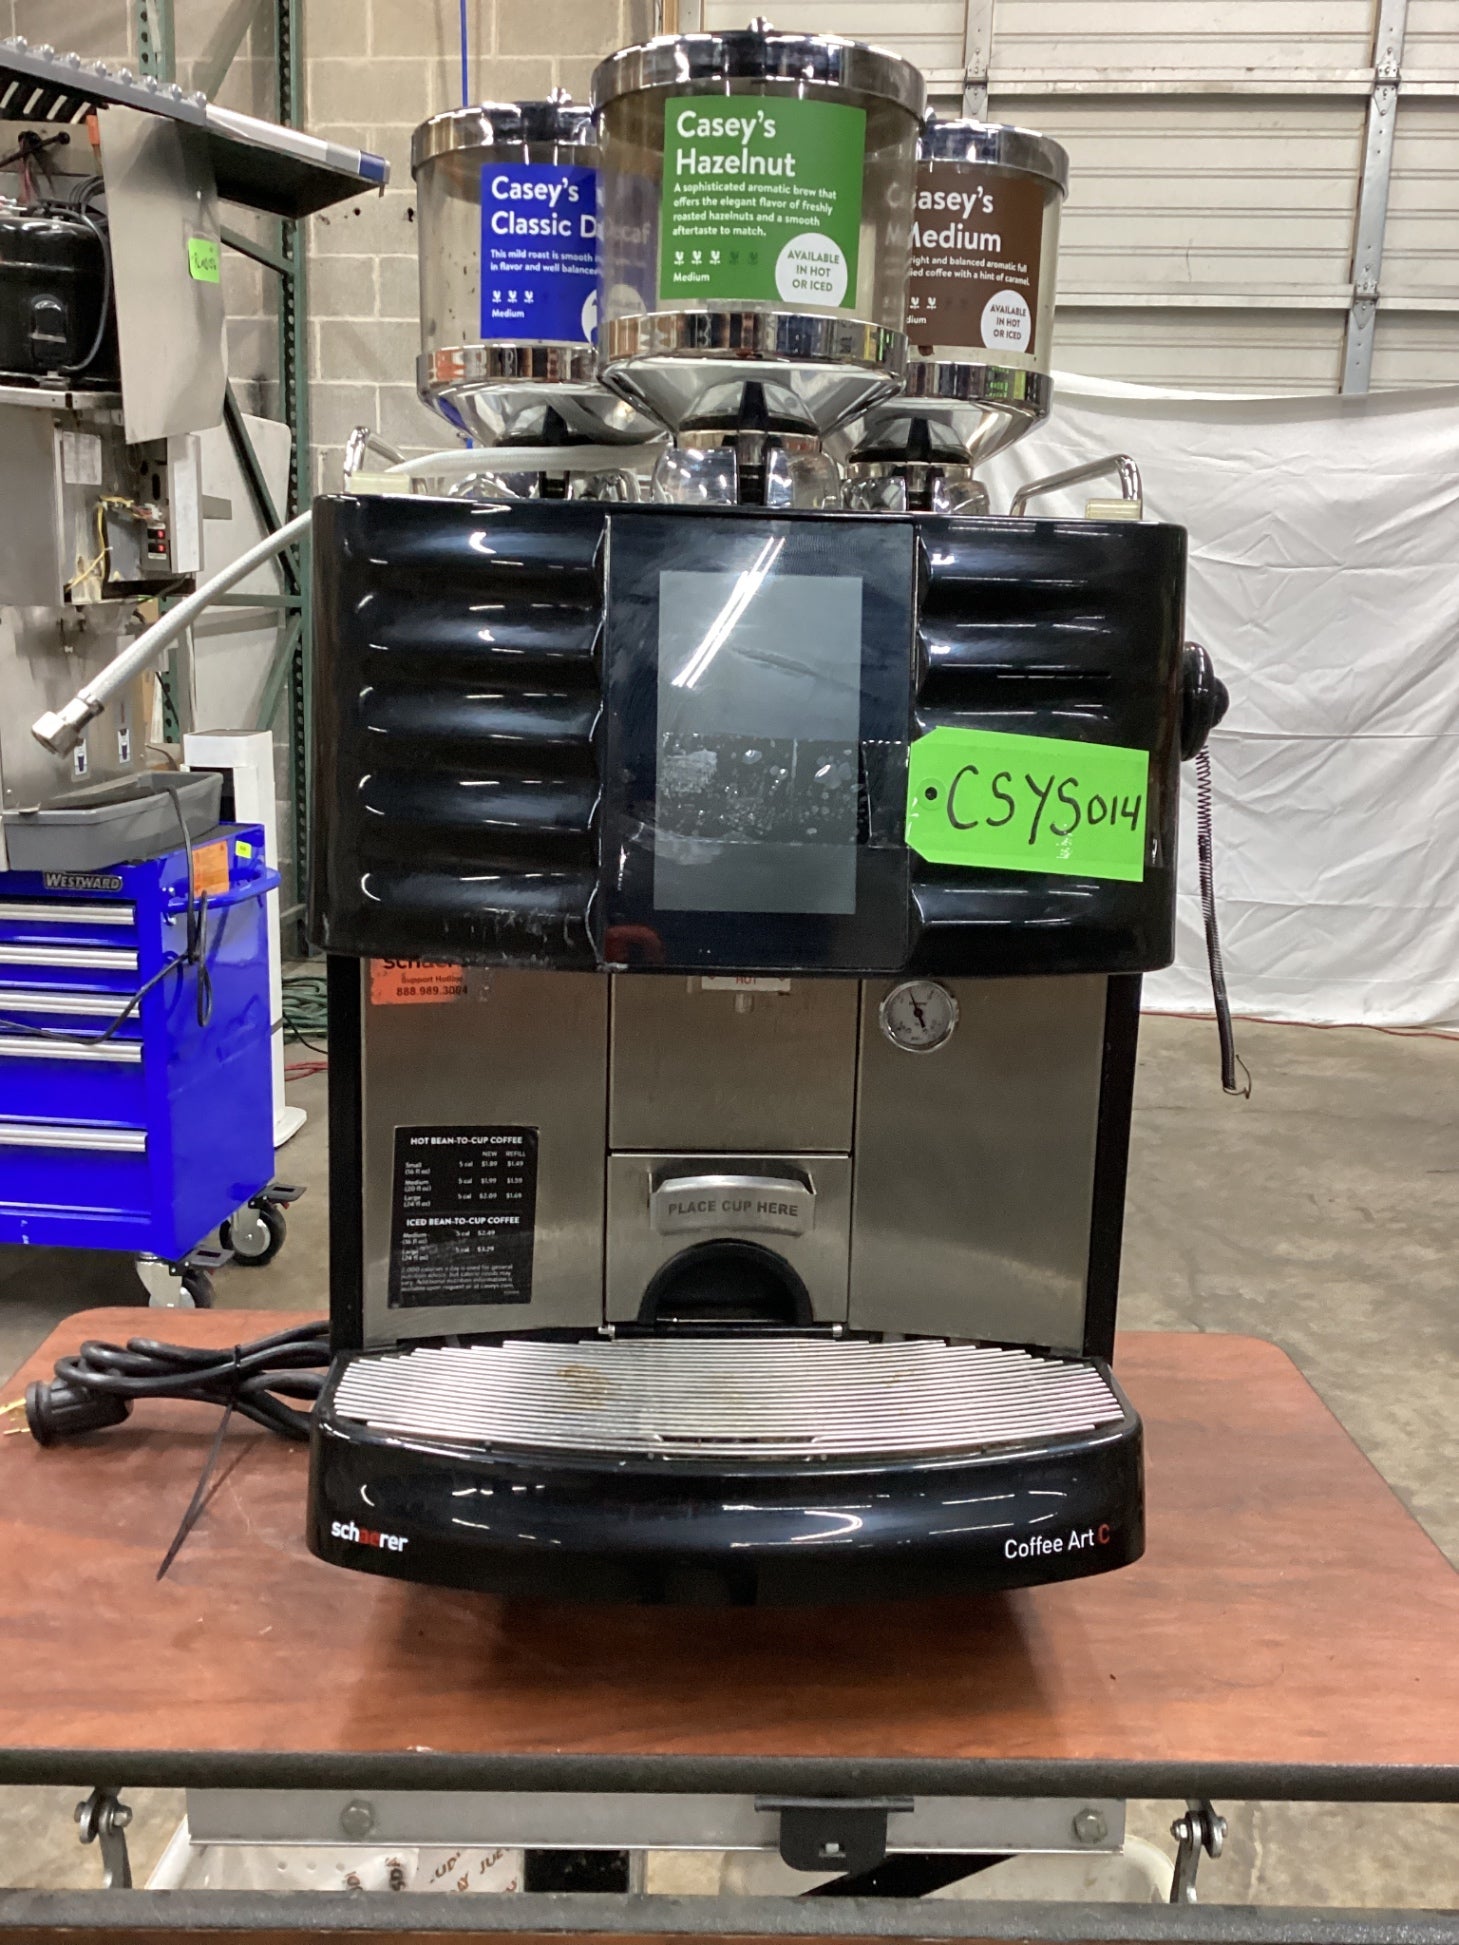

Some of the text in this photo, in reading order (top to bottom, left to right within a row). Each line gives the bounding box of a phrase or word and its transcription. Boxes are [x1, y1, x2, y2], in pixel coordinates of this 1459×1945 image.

[676, 110, 776, 145] Casey's
[676, 147, 796, 177] Hazelnut
[491, 176, 579, 208] Casey's
[673, 181, 837, 200] A sophisticated aromatic brew that
[673, 197, 833, 217] offers the elegant flavor of freshly
[491, 210, 572, 237] Classic
[673, 211, 820, 227] roasted hazelnuts and a smooth
[672, 225, 767, 237] aftertaste to match.
[490, 249, 507, 259] This
[508, 249, 527, 259] mild
[528, 250, 550, 260] roast
[552, 250, 560, 260] is
[561, 252, 593, 263] smooth
[787, 250, 840, 265] AVAILABLE
[490, 262, 499, 271] in
[500, 262, 523, 271] flavor
[525, 262, 541, 272] and
[543, 263, 560, 272] well
[796, 265, 831, 278] IN HOT
[931, 256, 948, 265] and
[950, 256, 985, 268] balanced
[986, 261, 1016, 271] aromatic
[1017, 263, 1027, 274] full
[673, 271, 710, 283] Medium
[925, 269, 952, 278] coffee
[954, 269, 972, 279] with
[979, 272, 994, 281] hint
[995, 273, 1004, 283] of
[792, 279, 833, 293] OR ICED
[491, 308, 525, 319] Medium
[990, 303, 1027, 318] AVAILABLE
[996, 317, 1021, 328] IN HOT
[993, 329, 1022, 341] OR ICED
[410, 1136, 523, 1146] HOT BEAN-TO-CUP COFFEE
[464, 1160, 474, 1168] cal
[668, 1200, 799, 1217] PLACE CUP HERE
[407, 1216, 520, 1227] ICED BEAN-TO-CUP COFFEE
[331, 1520, 409, 1552] schaerer
[1004, 1523, 1111, 1559] Coffee Art C
